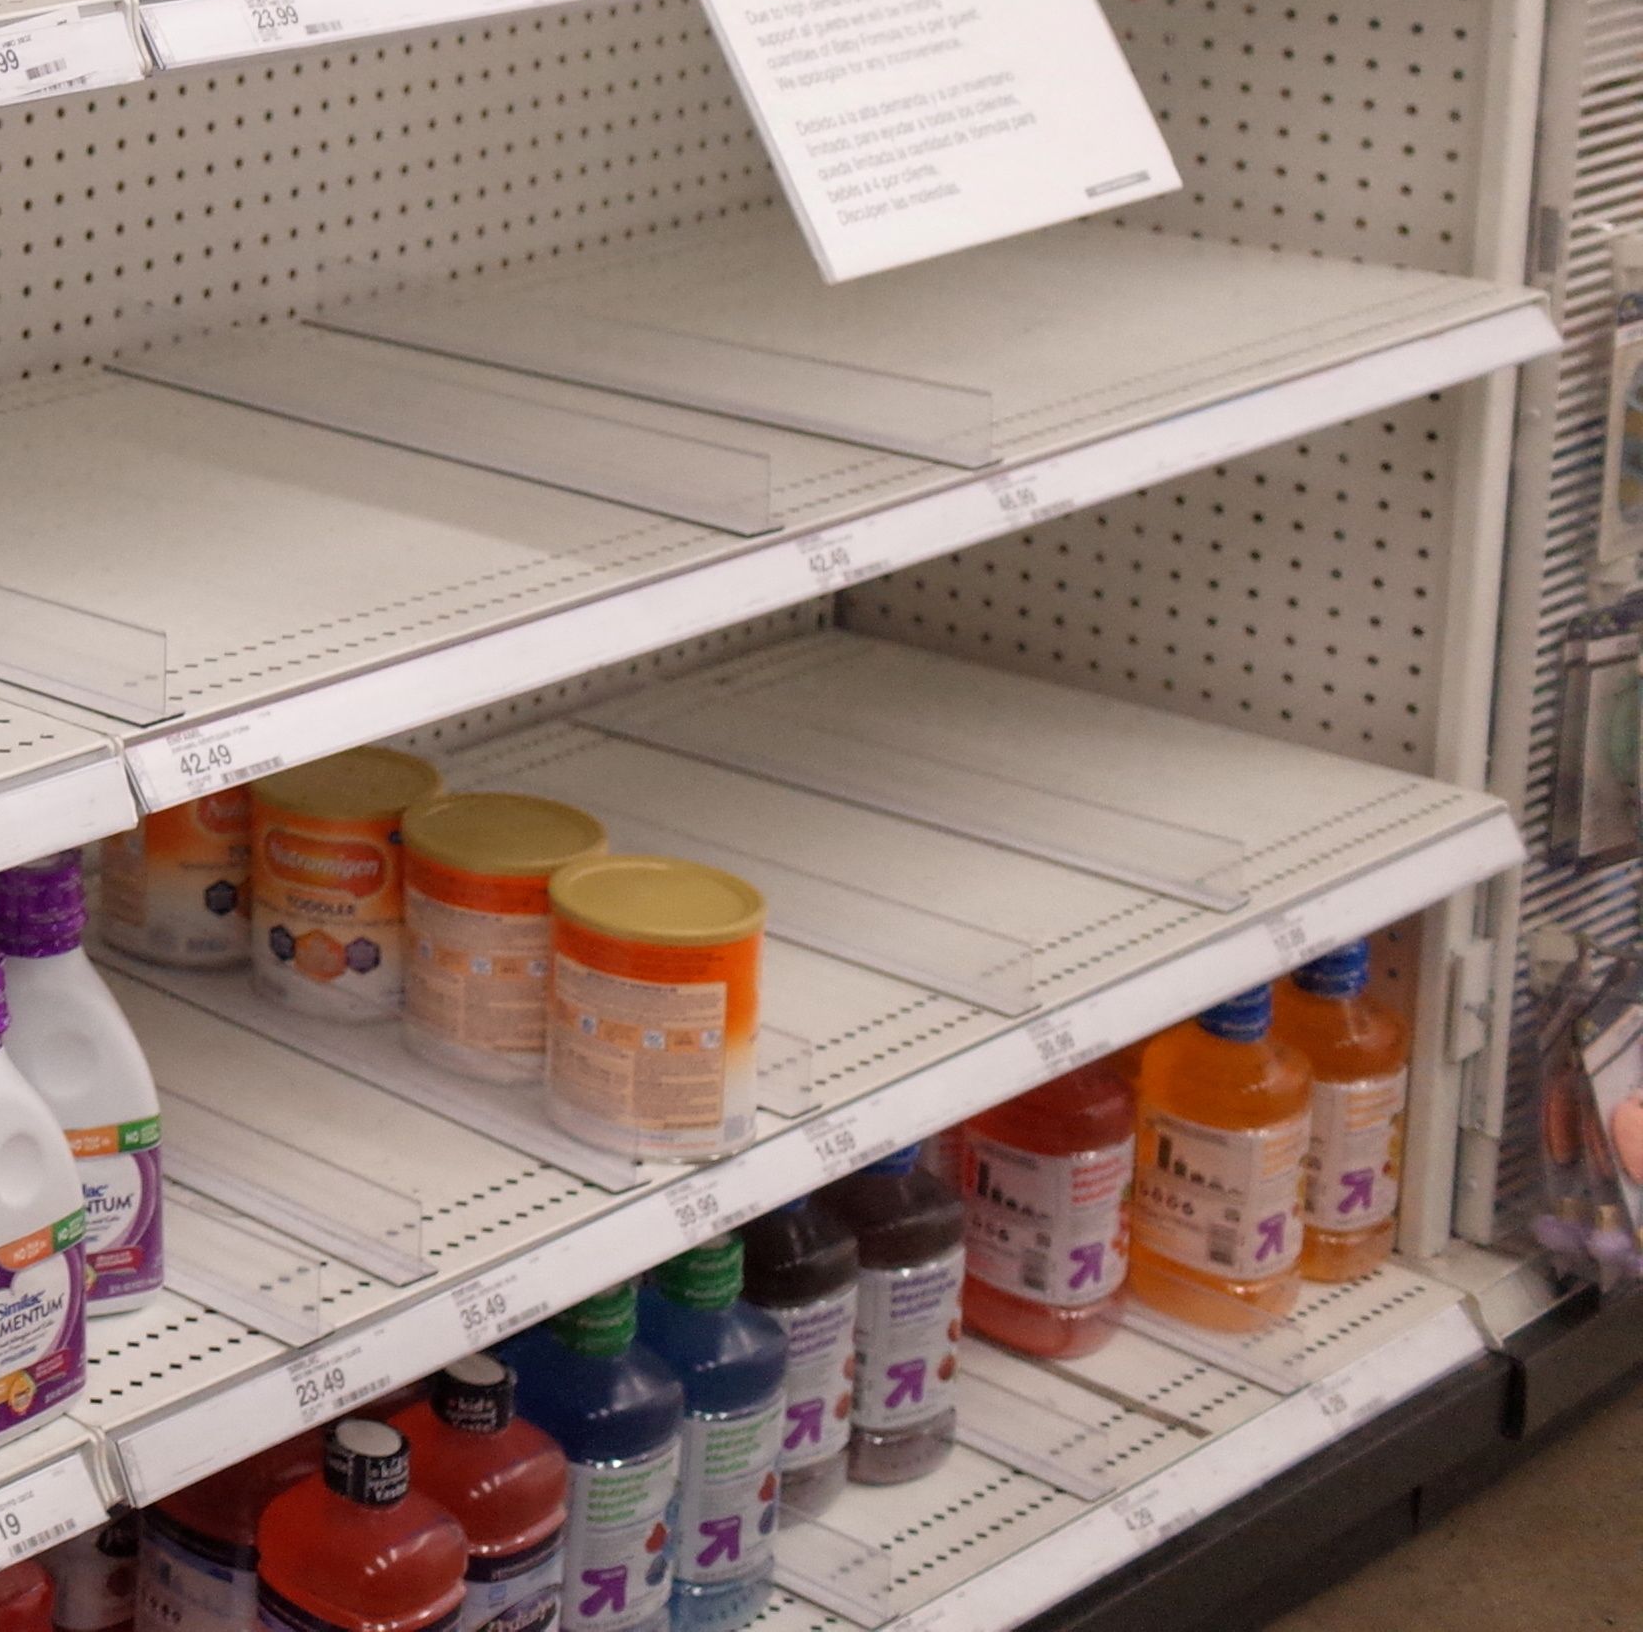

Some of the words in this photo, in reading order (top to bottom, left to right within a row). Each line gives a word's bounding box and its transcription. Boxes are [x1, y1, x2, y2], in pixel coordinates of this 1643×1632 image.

[252, 5, 300, 31] 23.99
[180, 743, 233, 776] 42.49
[459, 1293, 507, 1331] 35.49
[295, 1367, 346, 1408] 23.49
